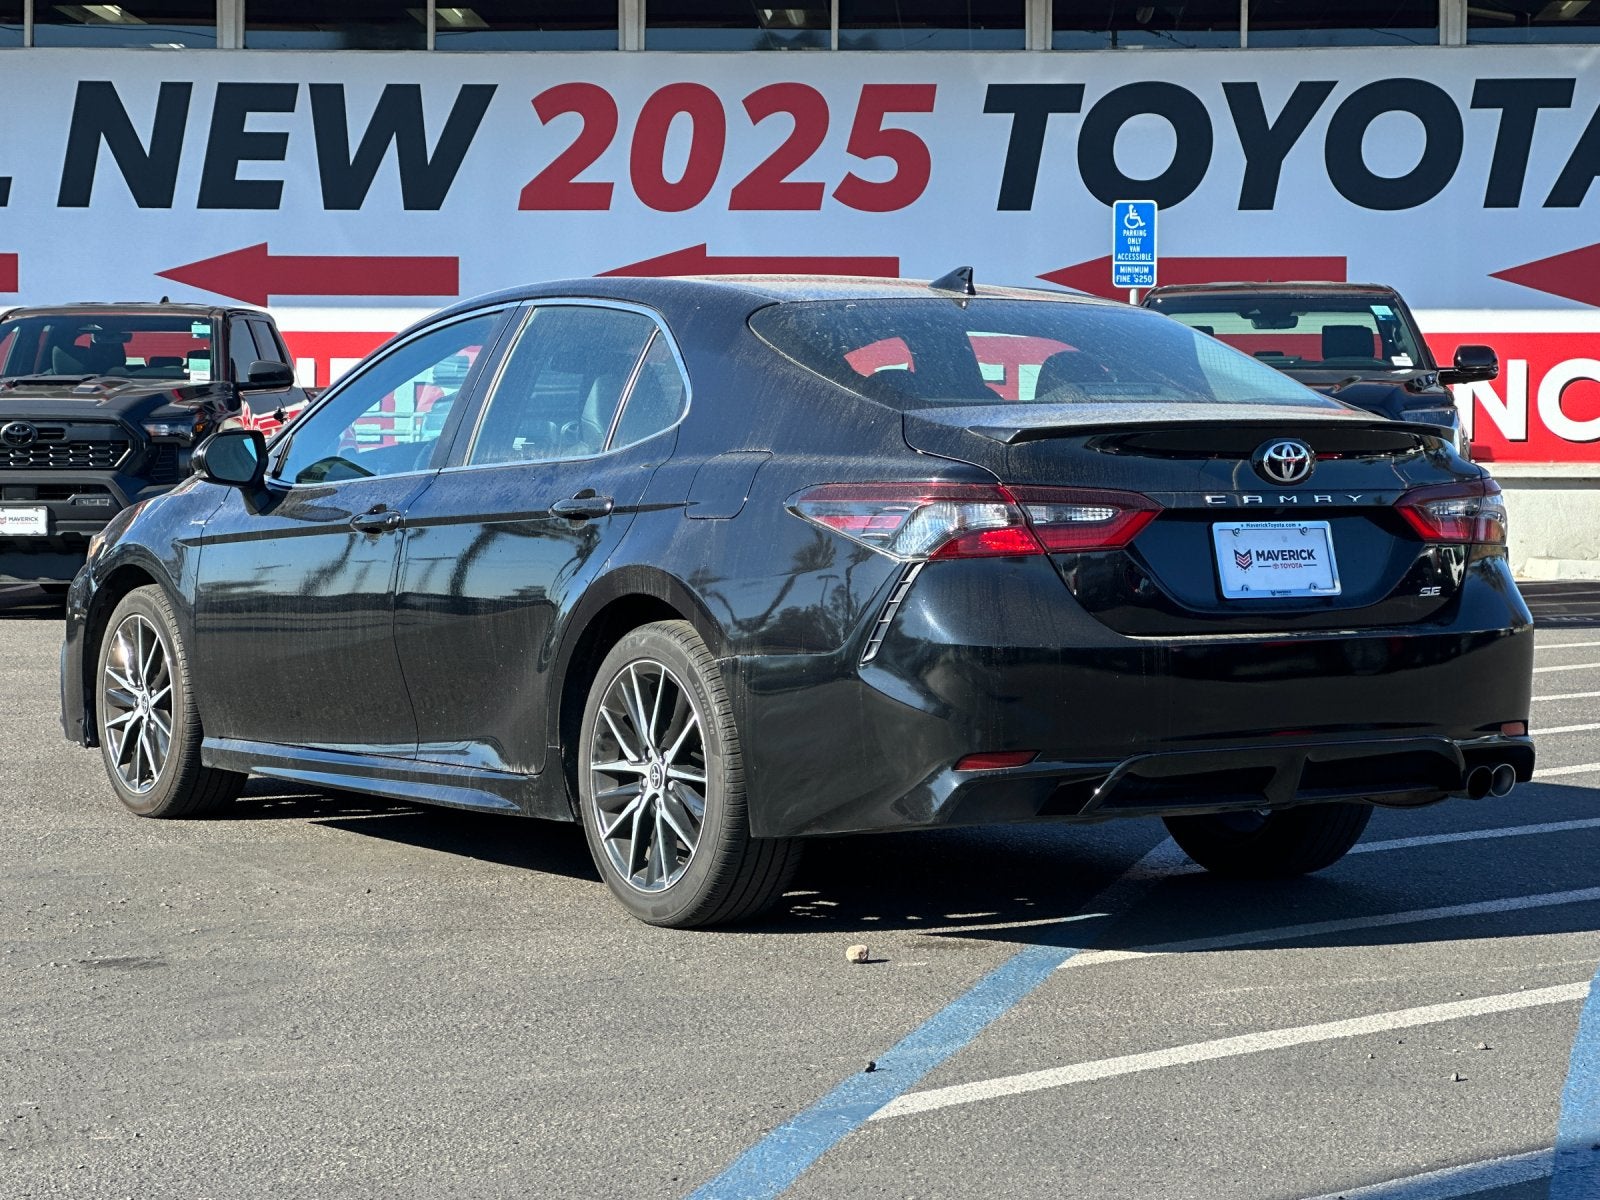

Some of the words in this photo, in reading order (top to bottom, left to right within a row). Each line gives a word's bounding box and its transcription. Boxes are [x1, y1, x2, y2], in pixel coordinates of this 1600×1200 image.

[58, 81, 498, 211] NEW
[520, 83, 936, 212] 2025
[1117, 253, 1152, 261] ACCESSIBLE
[1120, 266, 1149, 274] MINIMUM
[1116, 275, 1131, 283] FINE
[1133, 274, 1152, 283] $250
[1205, 494, 1363, 504] CAMRY
[1255, 549, 1317, 561] MAVERICK
[1419, 586, 1442, 597] SE
